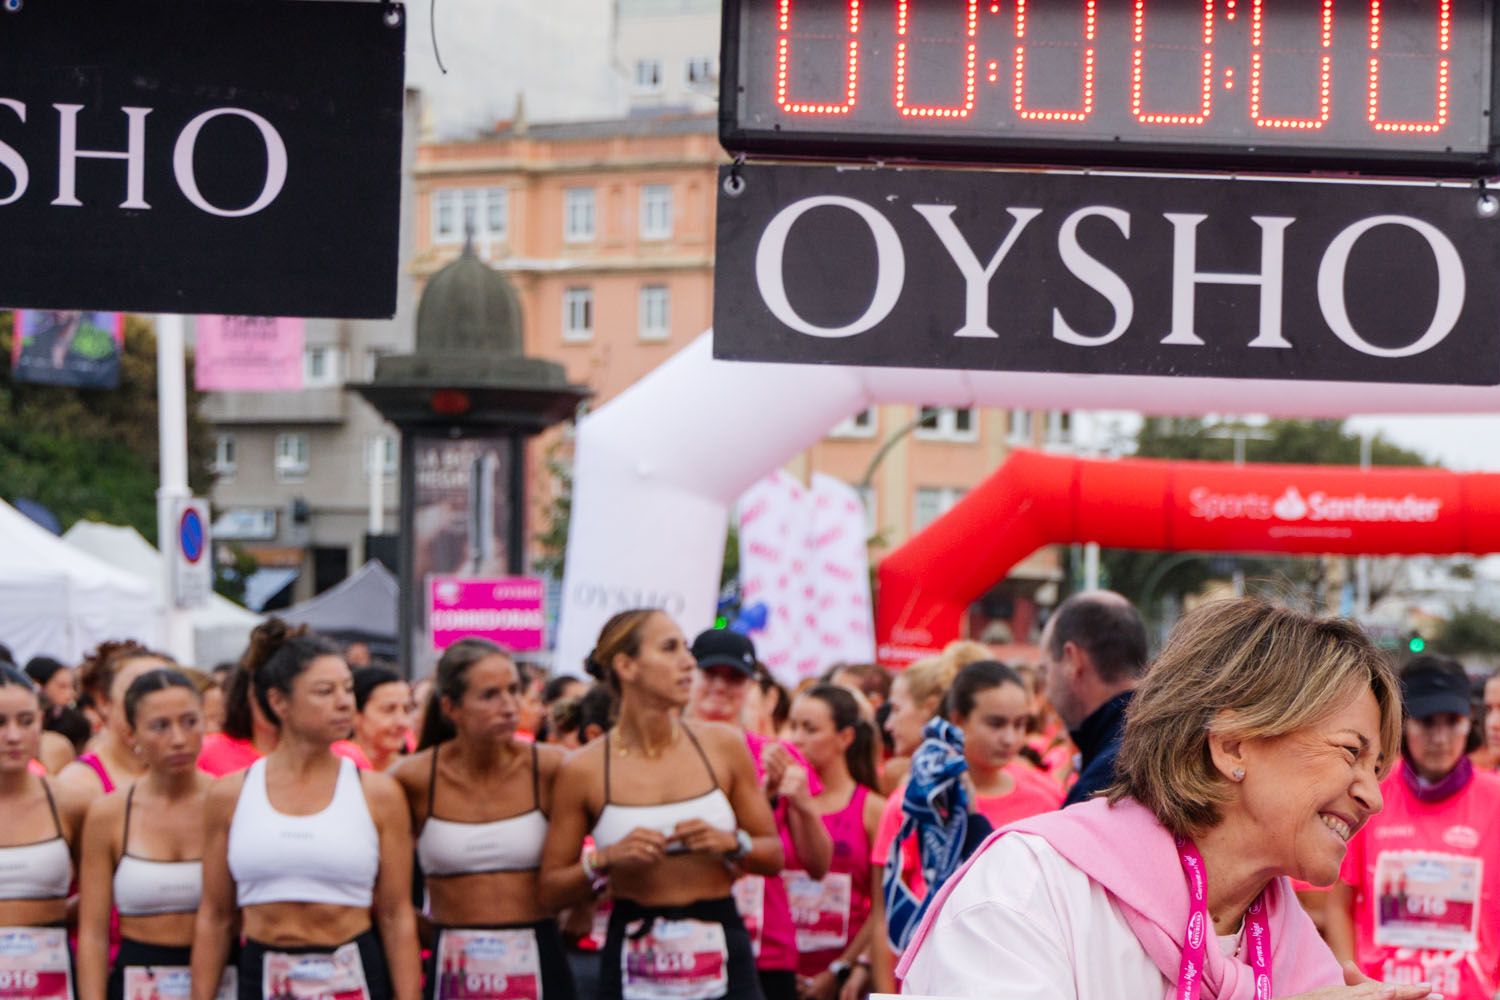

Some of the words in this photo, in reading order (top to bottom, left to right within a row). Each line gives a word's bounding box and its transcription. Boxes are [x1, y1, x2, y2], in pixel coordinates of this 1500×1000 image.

[756, 195, 1467, 359] OYSHO
[1189, 486, 1272, 521] Sports
[1308, 491, 1441, 522] Santander
[466, 973, 508, 993] 016
